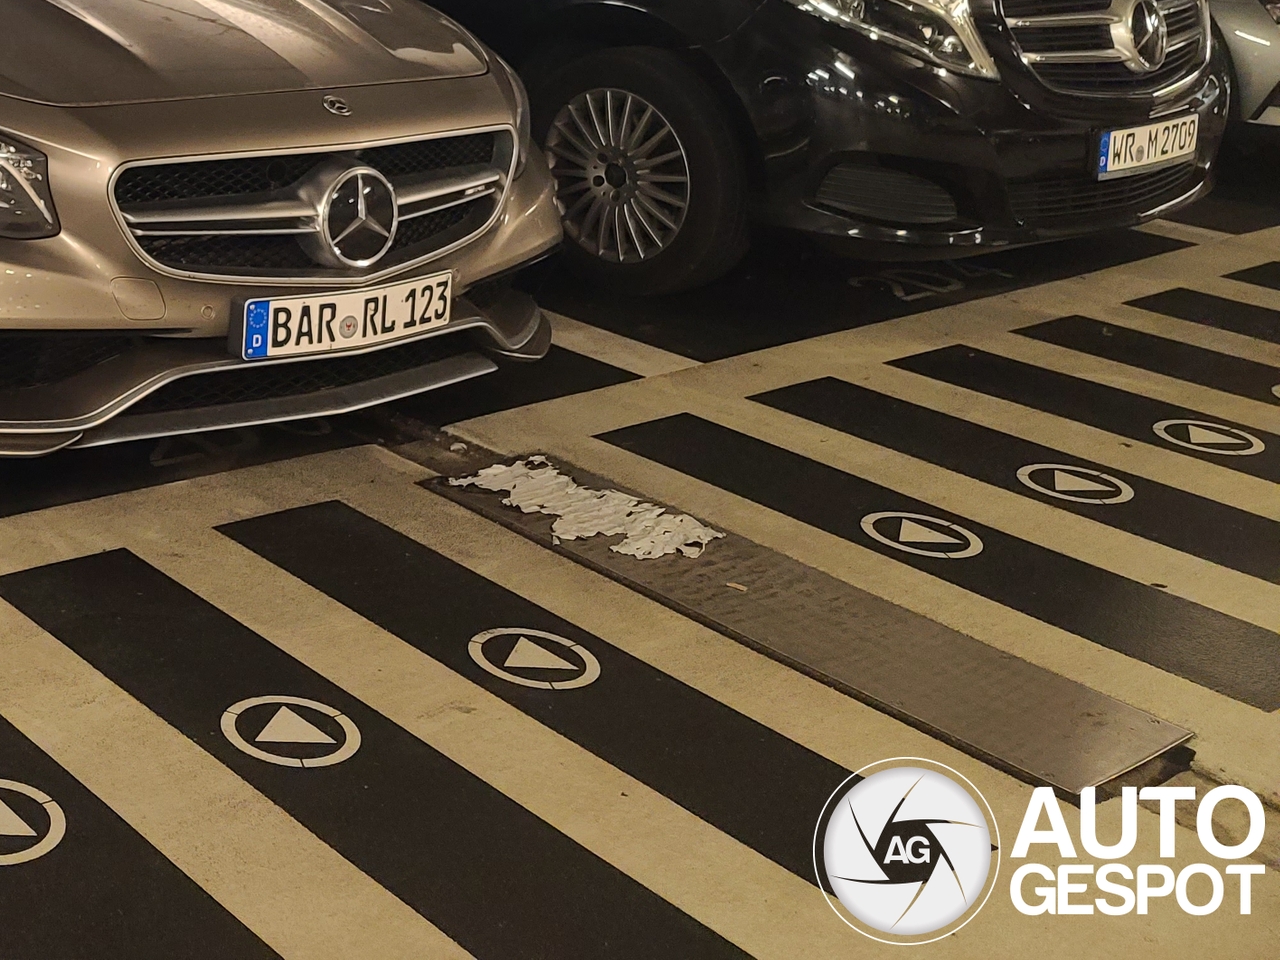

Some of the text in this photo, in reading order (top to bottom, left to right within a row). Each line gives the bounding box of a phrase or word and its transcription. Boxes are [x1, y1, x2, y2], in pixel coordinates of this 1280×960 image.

[1112, 119, 1196, 166] WR M 2709
[1100, 156, 1106, 166] D
[271, 281, 449, 348] BAR RL 123
[252, 334, 262, 347] D
